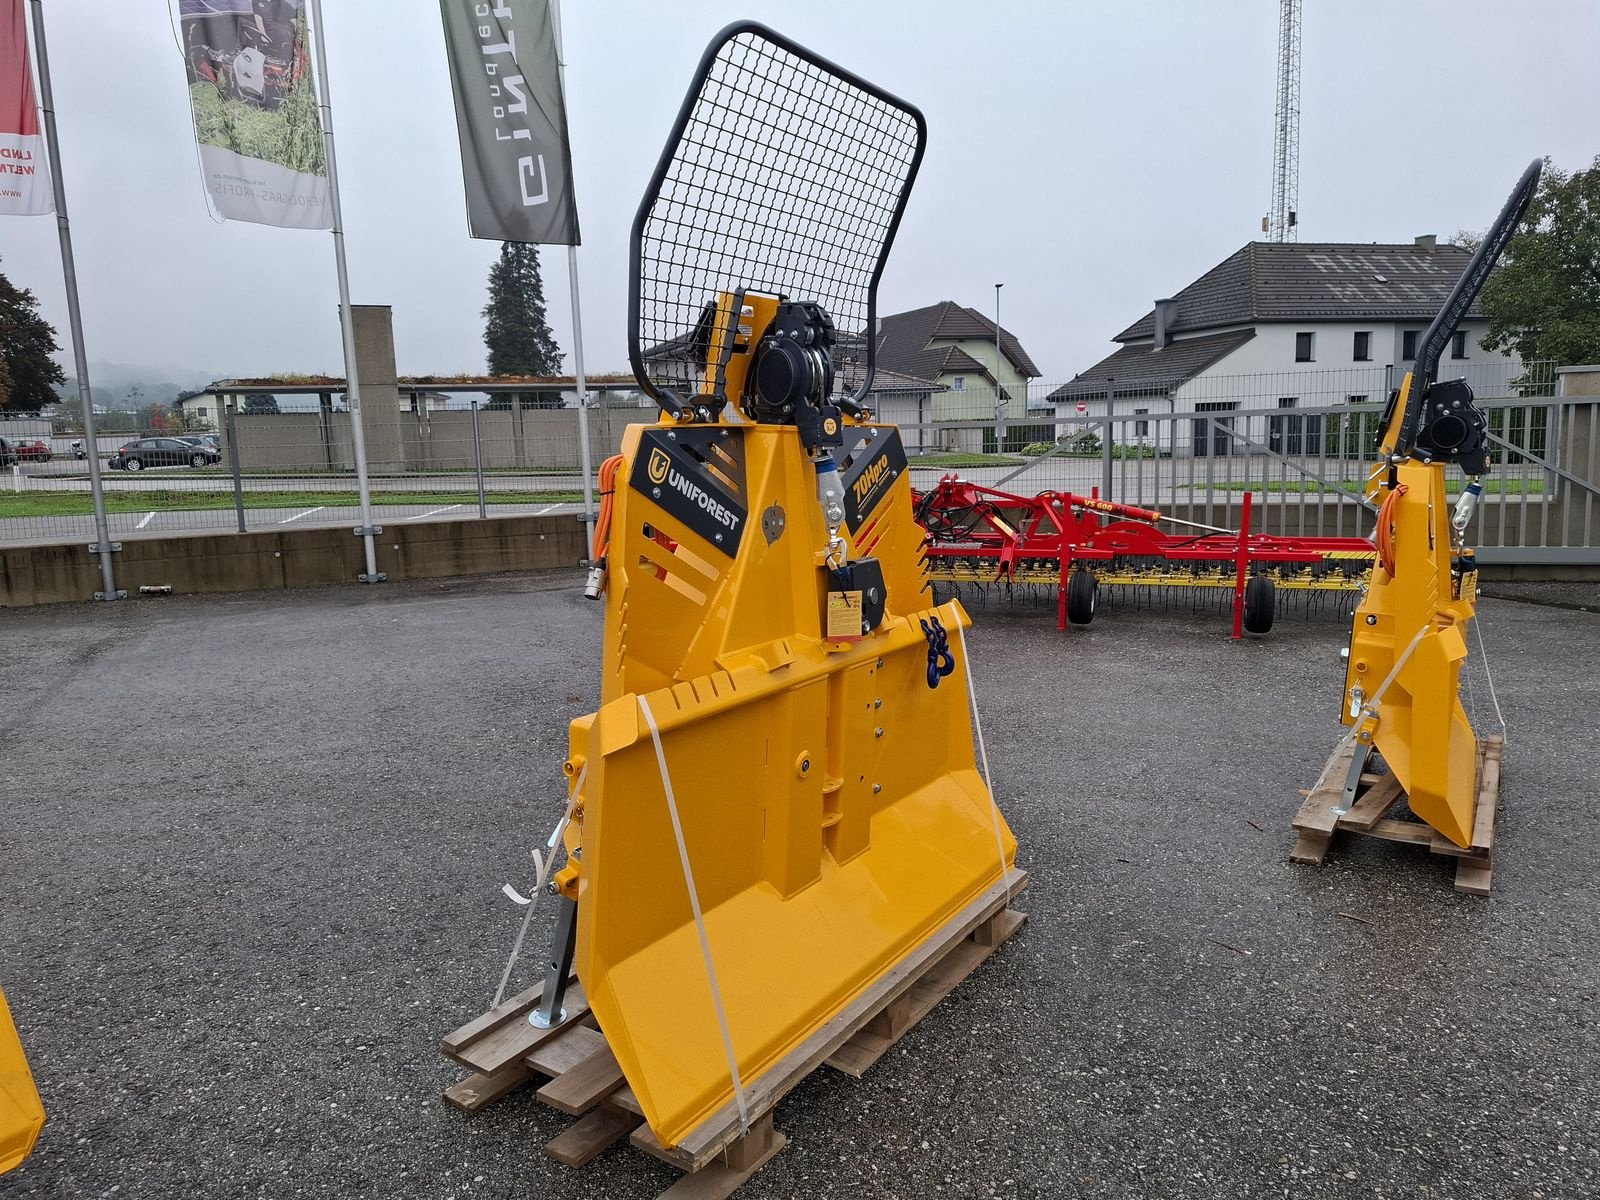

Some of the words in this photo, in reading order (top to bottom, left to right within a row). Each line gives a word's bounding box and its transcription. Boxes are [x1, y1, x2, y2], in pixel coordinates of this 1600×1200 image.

[668, 468, 740, 531] UNIFOREST
[853, 454, 888, 504] 70Hpro
[1084, 499, 1095, 508] VS
[1097, 502, 1113, 511] 600
